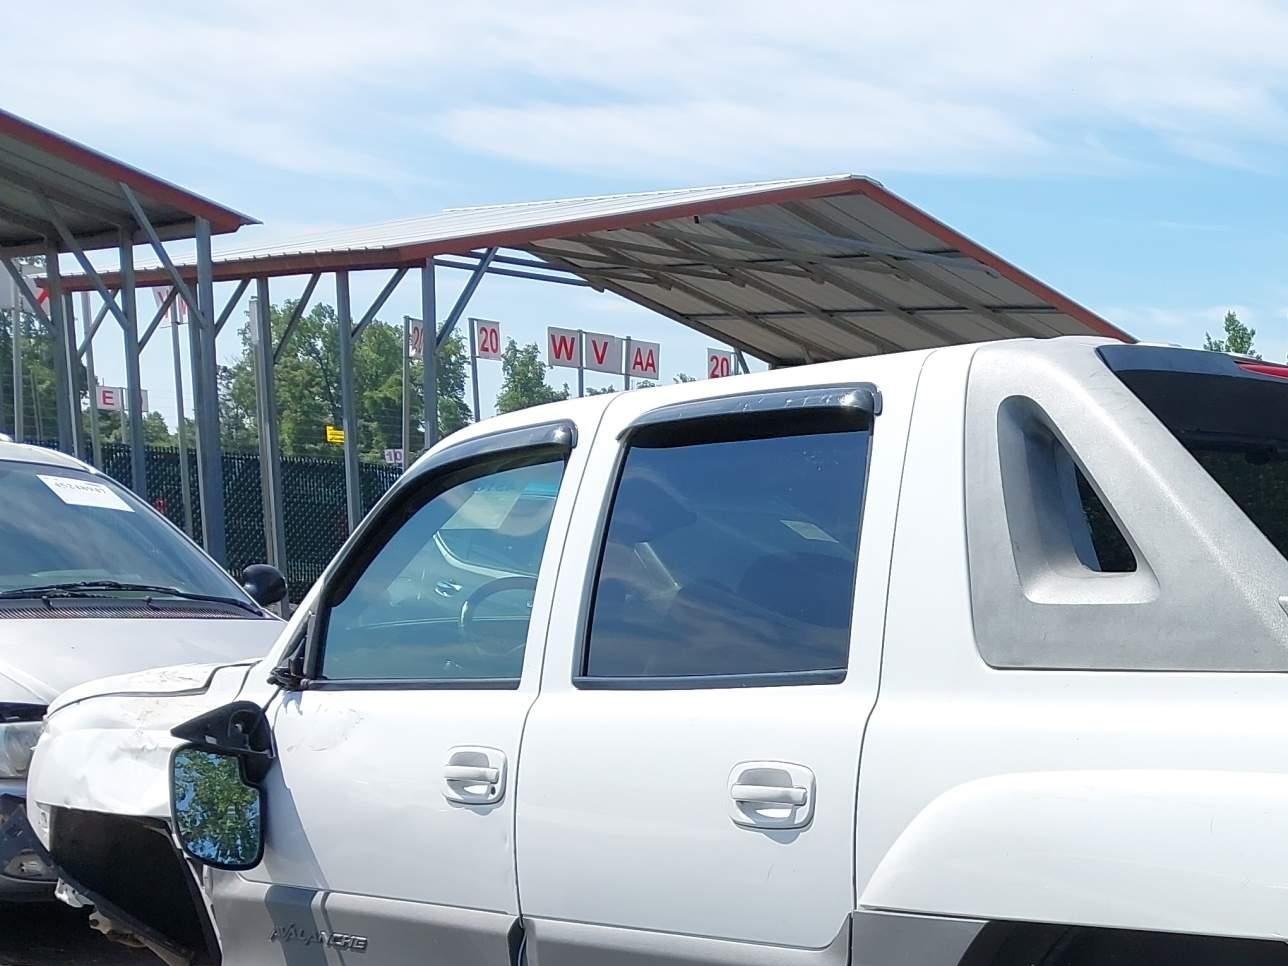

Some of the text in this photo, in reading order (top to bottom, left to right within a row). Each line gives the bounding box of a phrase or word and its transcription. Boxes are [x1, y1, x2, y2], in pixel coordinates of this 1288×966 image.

[479, 326, 499, 354] 20
[551, 334, 575, 361] W
[592, 340, 608, 365] V
[632, 347, 656, 374] AA
[710, 355, 730, 379] 20
[102, 390, 114, 406] E
